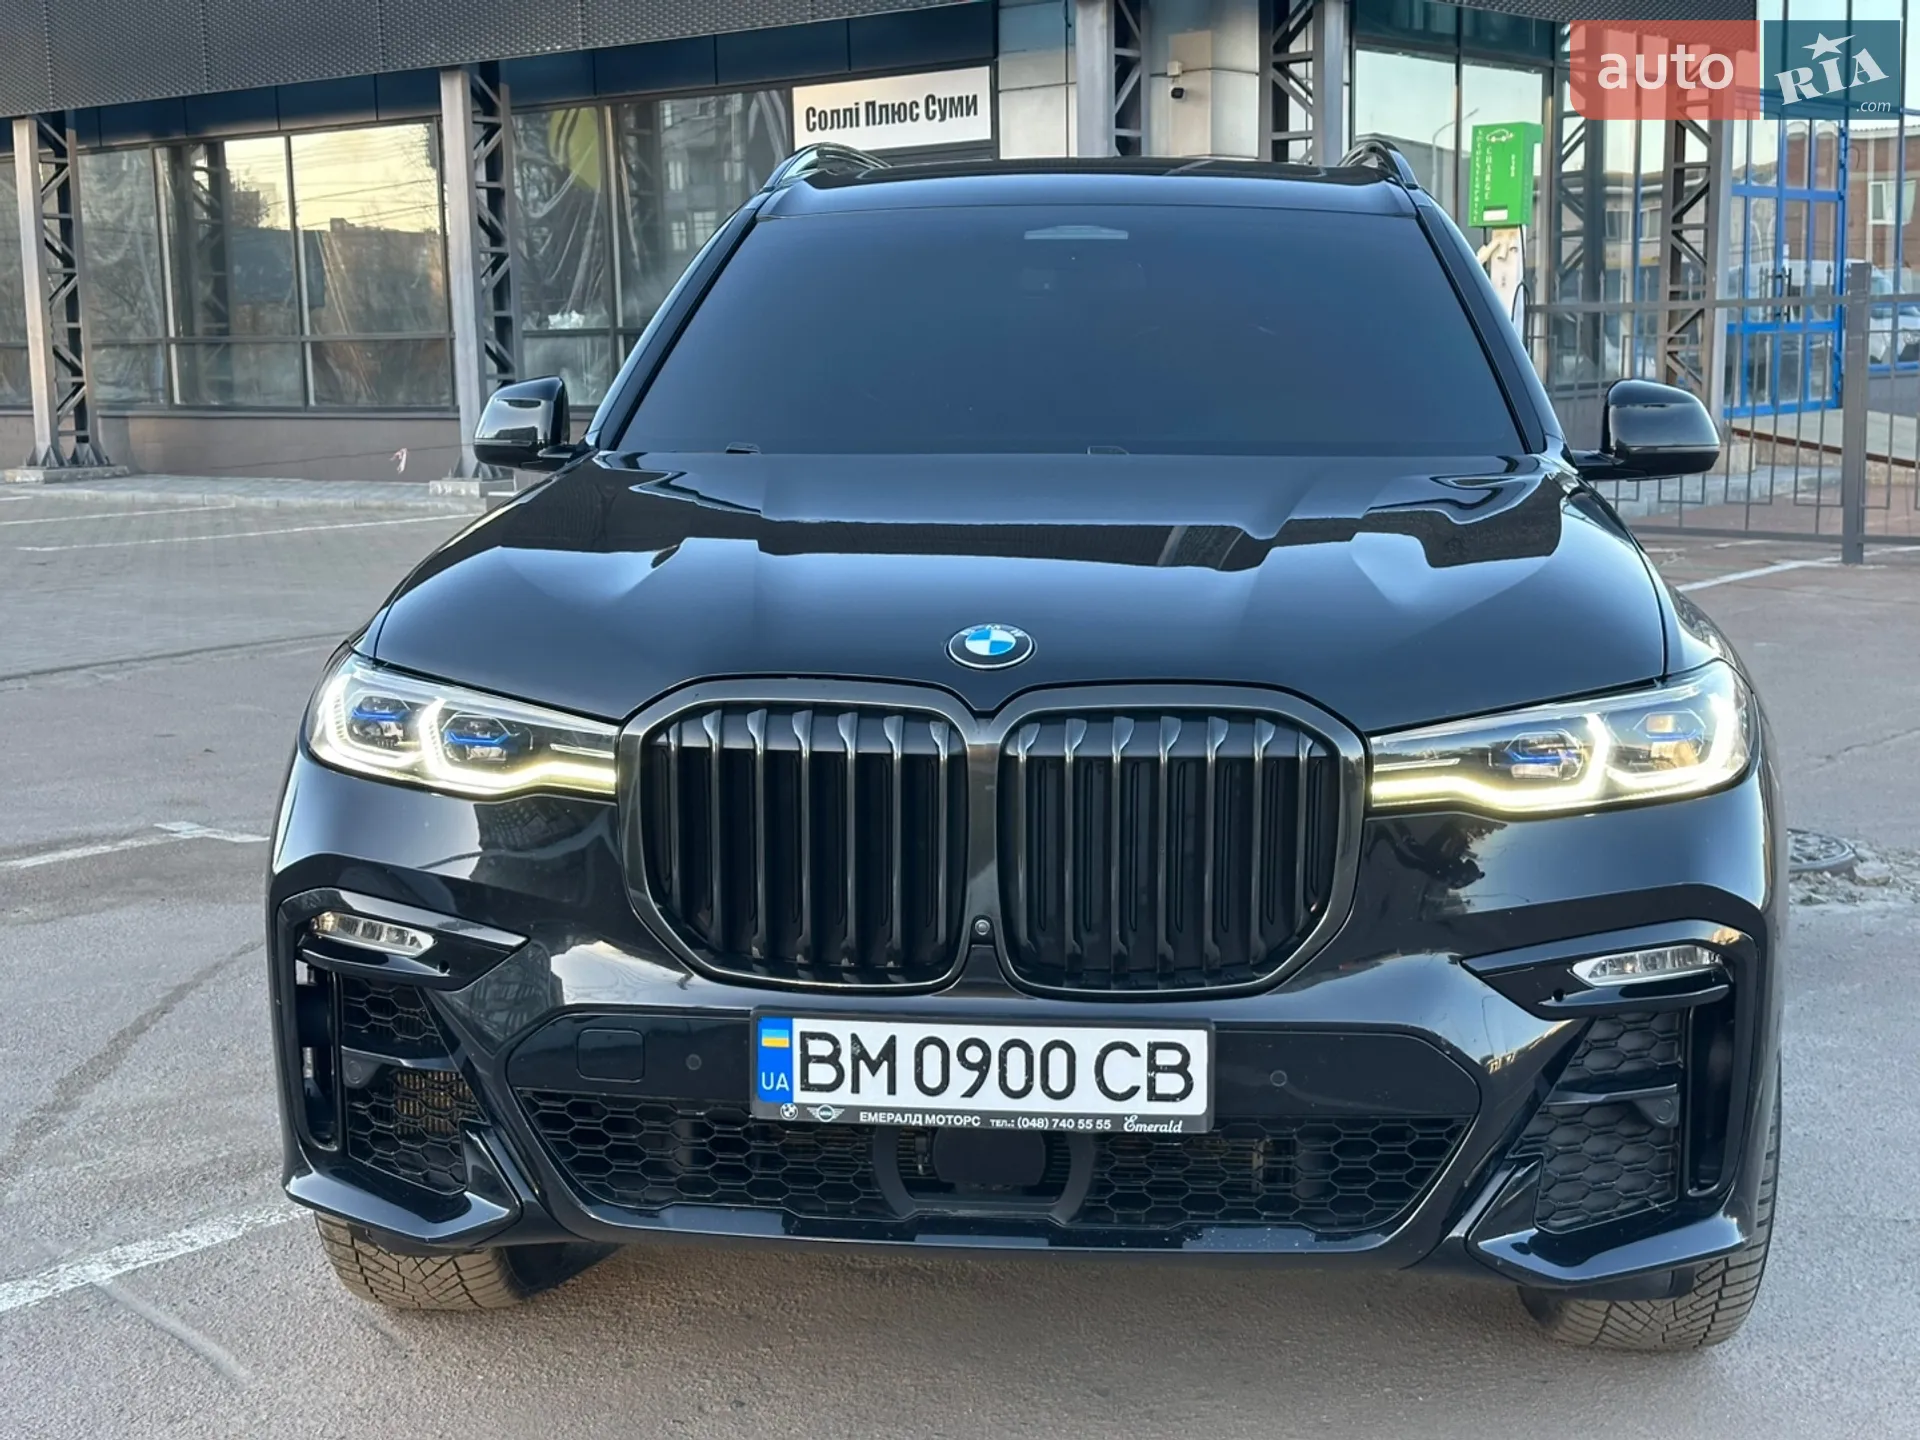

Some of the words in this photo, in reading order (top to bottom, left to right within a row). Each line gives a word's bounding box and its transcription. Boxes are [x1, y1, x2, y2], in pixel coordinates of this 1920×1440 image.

[805, 102, 860, 132] Соллі
[865, 100, 919, 127] Плюс
[924, 93, 978, 122] Суми
[799, 1031, 897, 1096] BM
[914, 1035, 1077, 1100] 0900
[1094, 1040, 1195, 1103] CB
[762, 1072, 790, 1092] UA
[859, 1111, 923, 1126] ЕМЕРАЛД
[925, 1113, 981, 1127] МОТОРС
[1017, 1116, 1050, 1130] (048)
[1052, 1118, 1075, 1130] 740
[1078, 1118, 1093, 1130] 55
[1095, 1118, 1112, 1130] 55
[1123, 1114, 1183, 1134] Emerald
